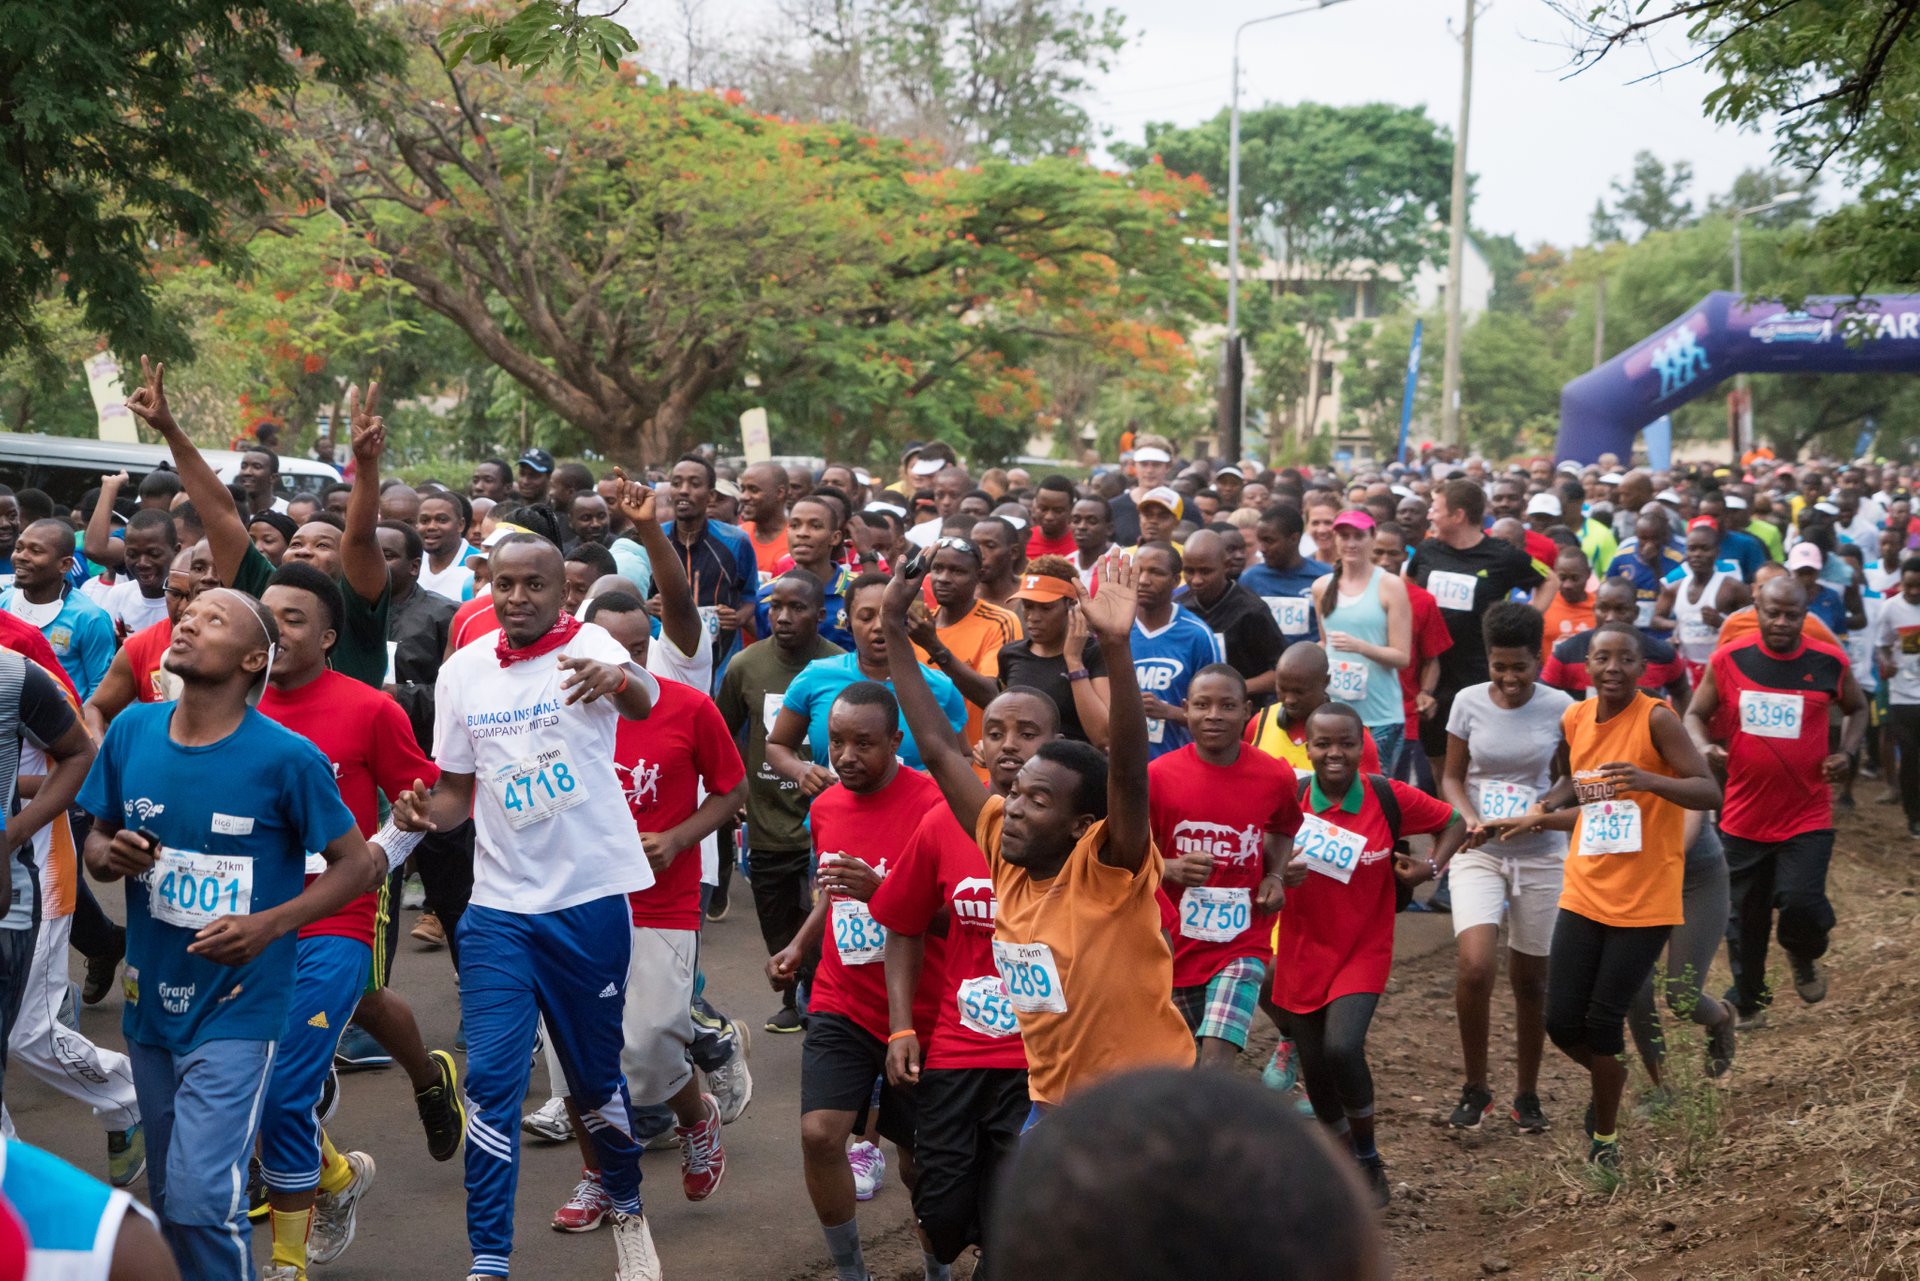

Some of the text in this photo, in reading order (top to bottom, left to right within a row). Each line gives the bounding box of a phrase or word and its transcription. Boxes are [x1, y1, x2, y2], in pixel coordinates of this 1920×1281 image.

[1026, 575, 1040, 589] T
[1435, 580, 1469, 601] 1179
[1276, 608, 1304, 625] 184
[1136, 666, 1172, 690] MB
[1332, 671, 1362, 691] 582
[467, 711, 511, 727] BUMACO
[1746, 703, 1796, 727] 3396
[472, 725, 524, 739] COMPANY
[536, 749, 561, 764] 21km
[505, 762, 575, 812] 4718
[1586, 815, 1634, 842] 5487
[1176, 836, 1232, 857] mic
[1294, 829, 1353, 869] 4269
[216, 860, 244, 871] 21km
[159, 870, 239, 912] 4001
[953, 897, 998, 918] mi
[1186, 901, 1246, 929] 2750
[1018, 949, 1041, 957] 21km
[996, 958, 1051, 997] 289
[159, 982, 195, 1000] Grand
[163, 998, 190, 1013] Malt
